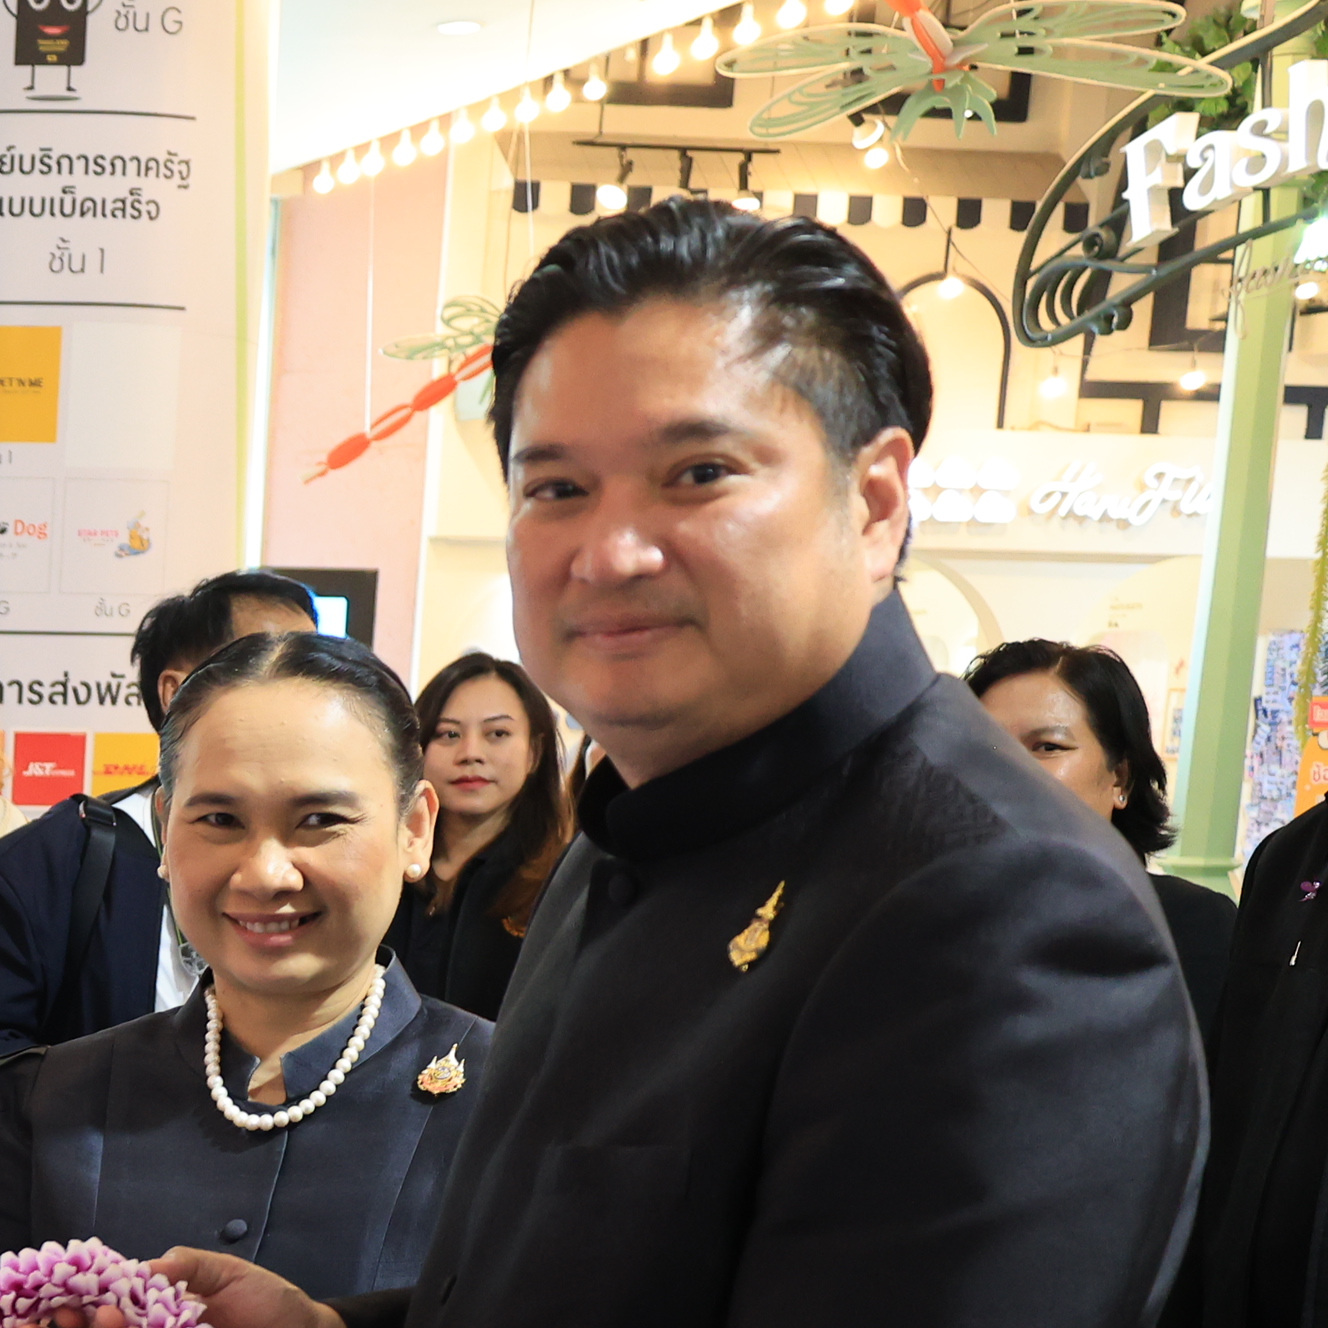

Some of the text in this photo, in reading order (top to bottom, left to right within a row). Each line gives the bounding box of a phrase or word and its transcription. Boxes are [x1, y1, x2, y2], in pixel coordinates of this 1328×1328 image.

[114, 0, 183, 35] ชัน G
[48, 236, 106, 275] ชั้น 1
[14, 519, 48, 541] Dog
[118, 602, 131, 618] G
